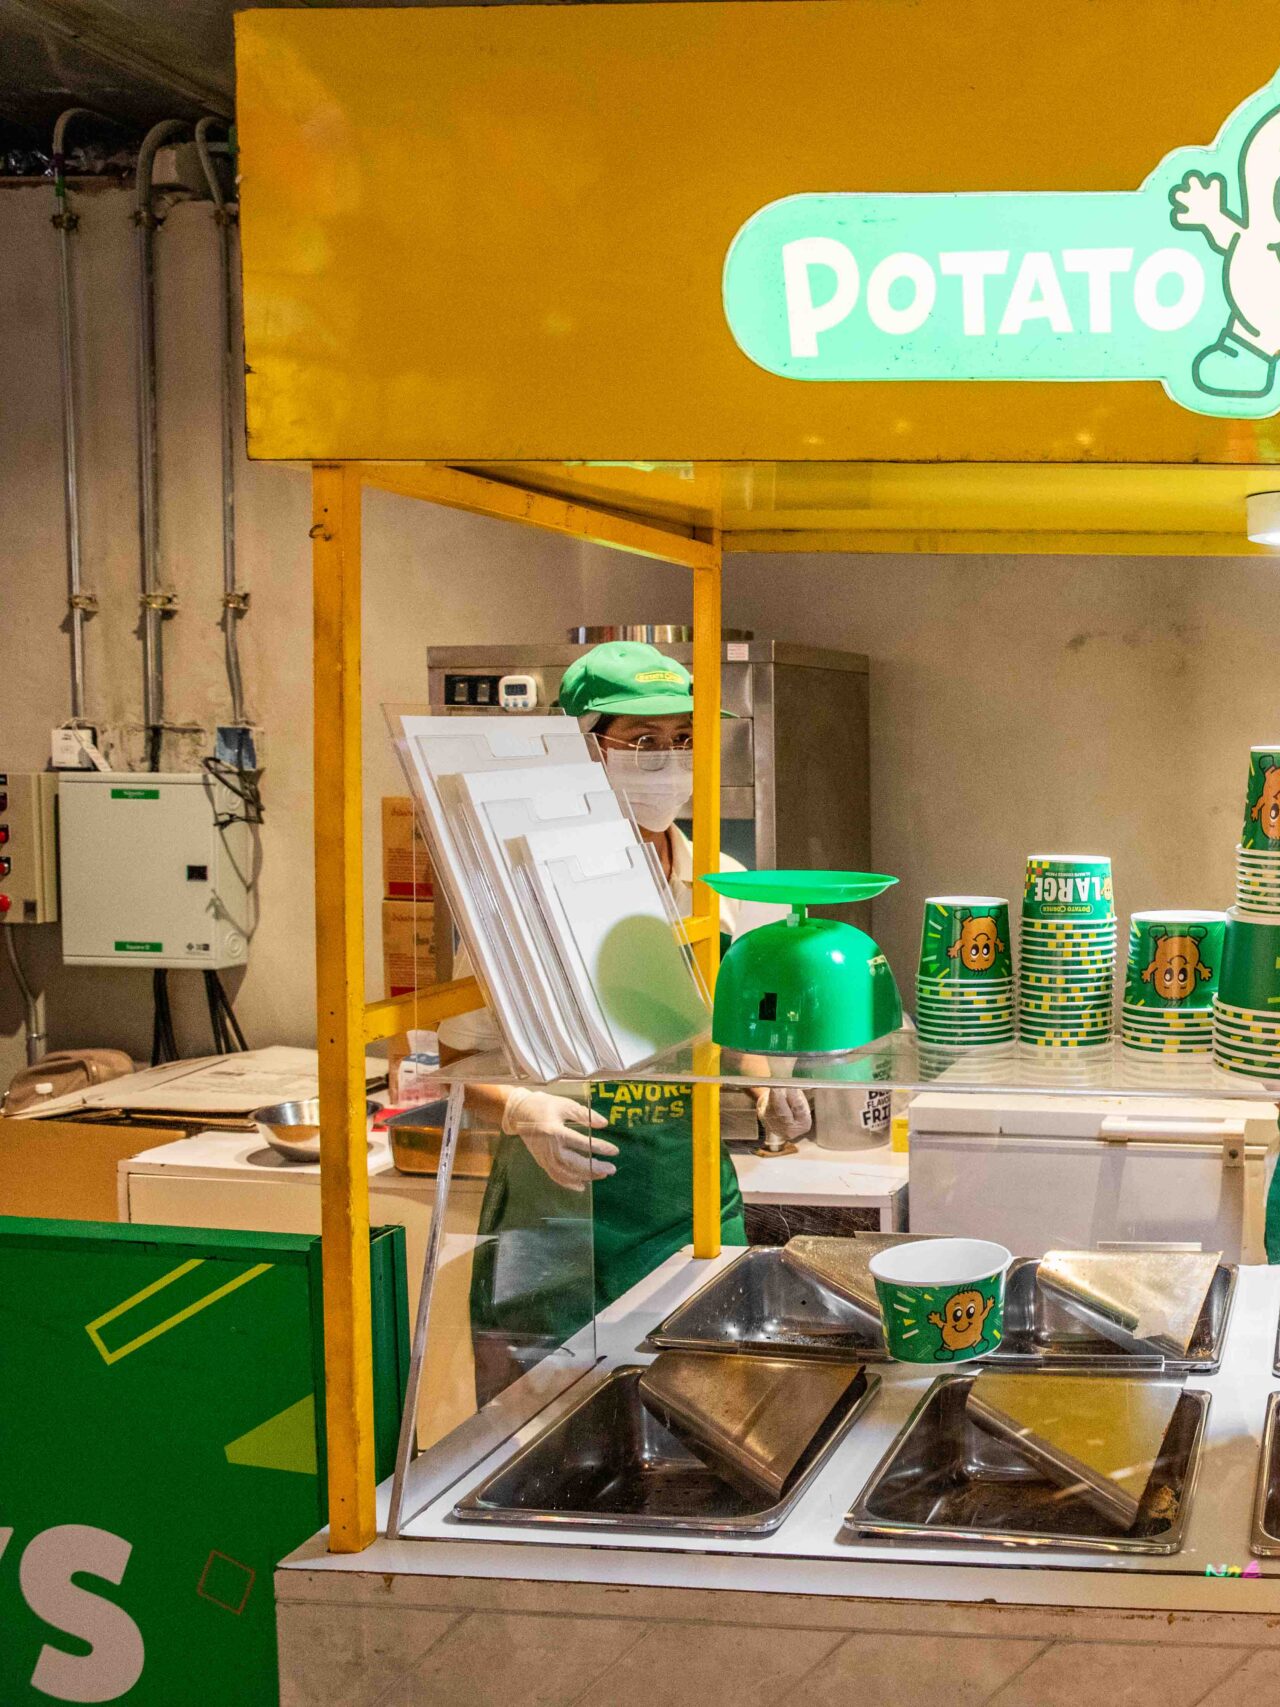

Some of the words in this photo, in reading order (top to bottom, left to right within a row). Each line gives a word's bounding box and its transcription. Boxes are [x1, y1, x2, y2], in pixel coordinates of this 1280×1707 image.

[783, 236, 1203, 358] POTATO
[1034, 877, 1101, 902] LARGE
[0, 1523, 145, 1704] S
